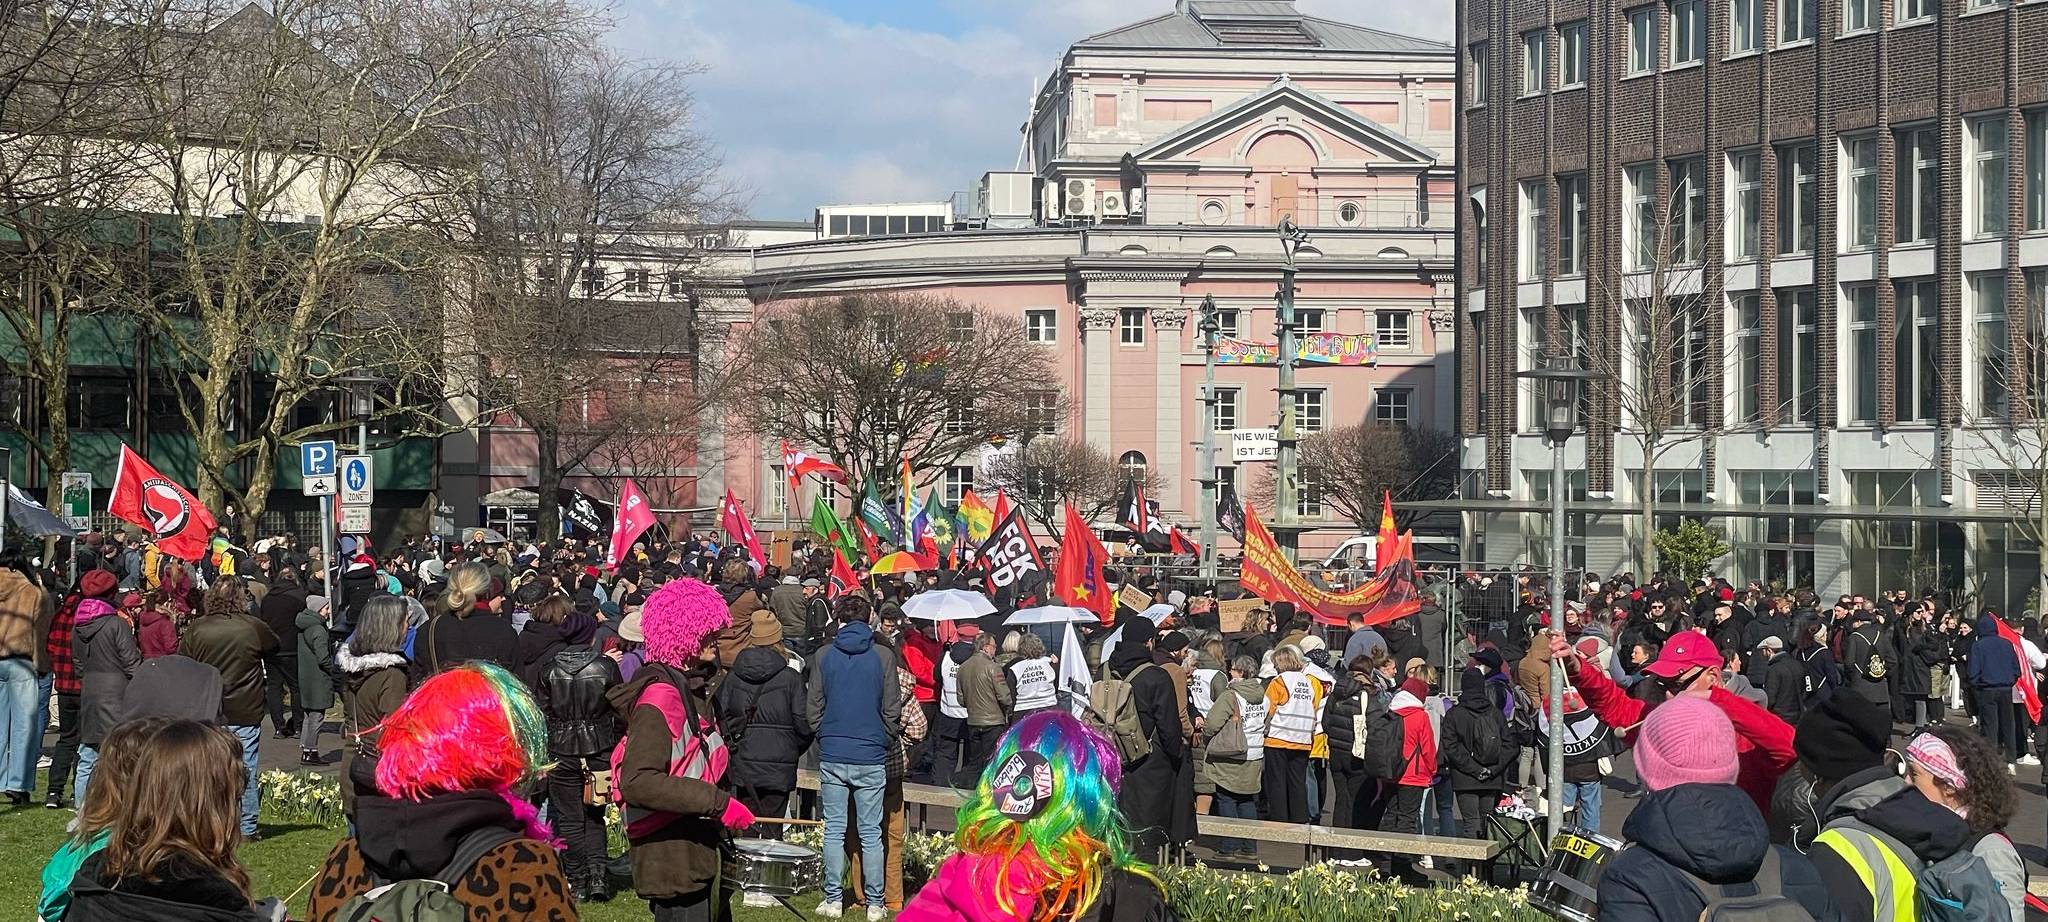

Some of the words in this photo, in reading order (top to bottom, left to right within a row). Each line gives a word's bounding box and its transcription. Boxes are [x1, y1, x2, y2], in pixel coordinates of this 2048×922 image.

[1218, 337, 1269, 356] ESSEN
[1233, 433, 1253, 441] NIE
[1254, 432, 1301, 441] WIER
[1237, 447, 1255, 456] IST
[1258, 447, 1279, 456] JET
[310, 446, 327, 472] P
[348, 493, 364, 501] ZONE
[567, 510, 598, 532] NAZIS
[1000, 521, 1038, 580] FCK
[1022, 670, 1045, 679] GEGEN
[1022, 676, 1047, 685] RECHTS
[1002, 795, 1033, 813] bunt
